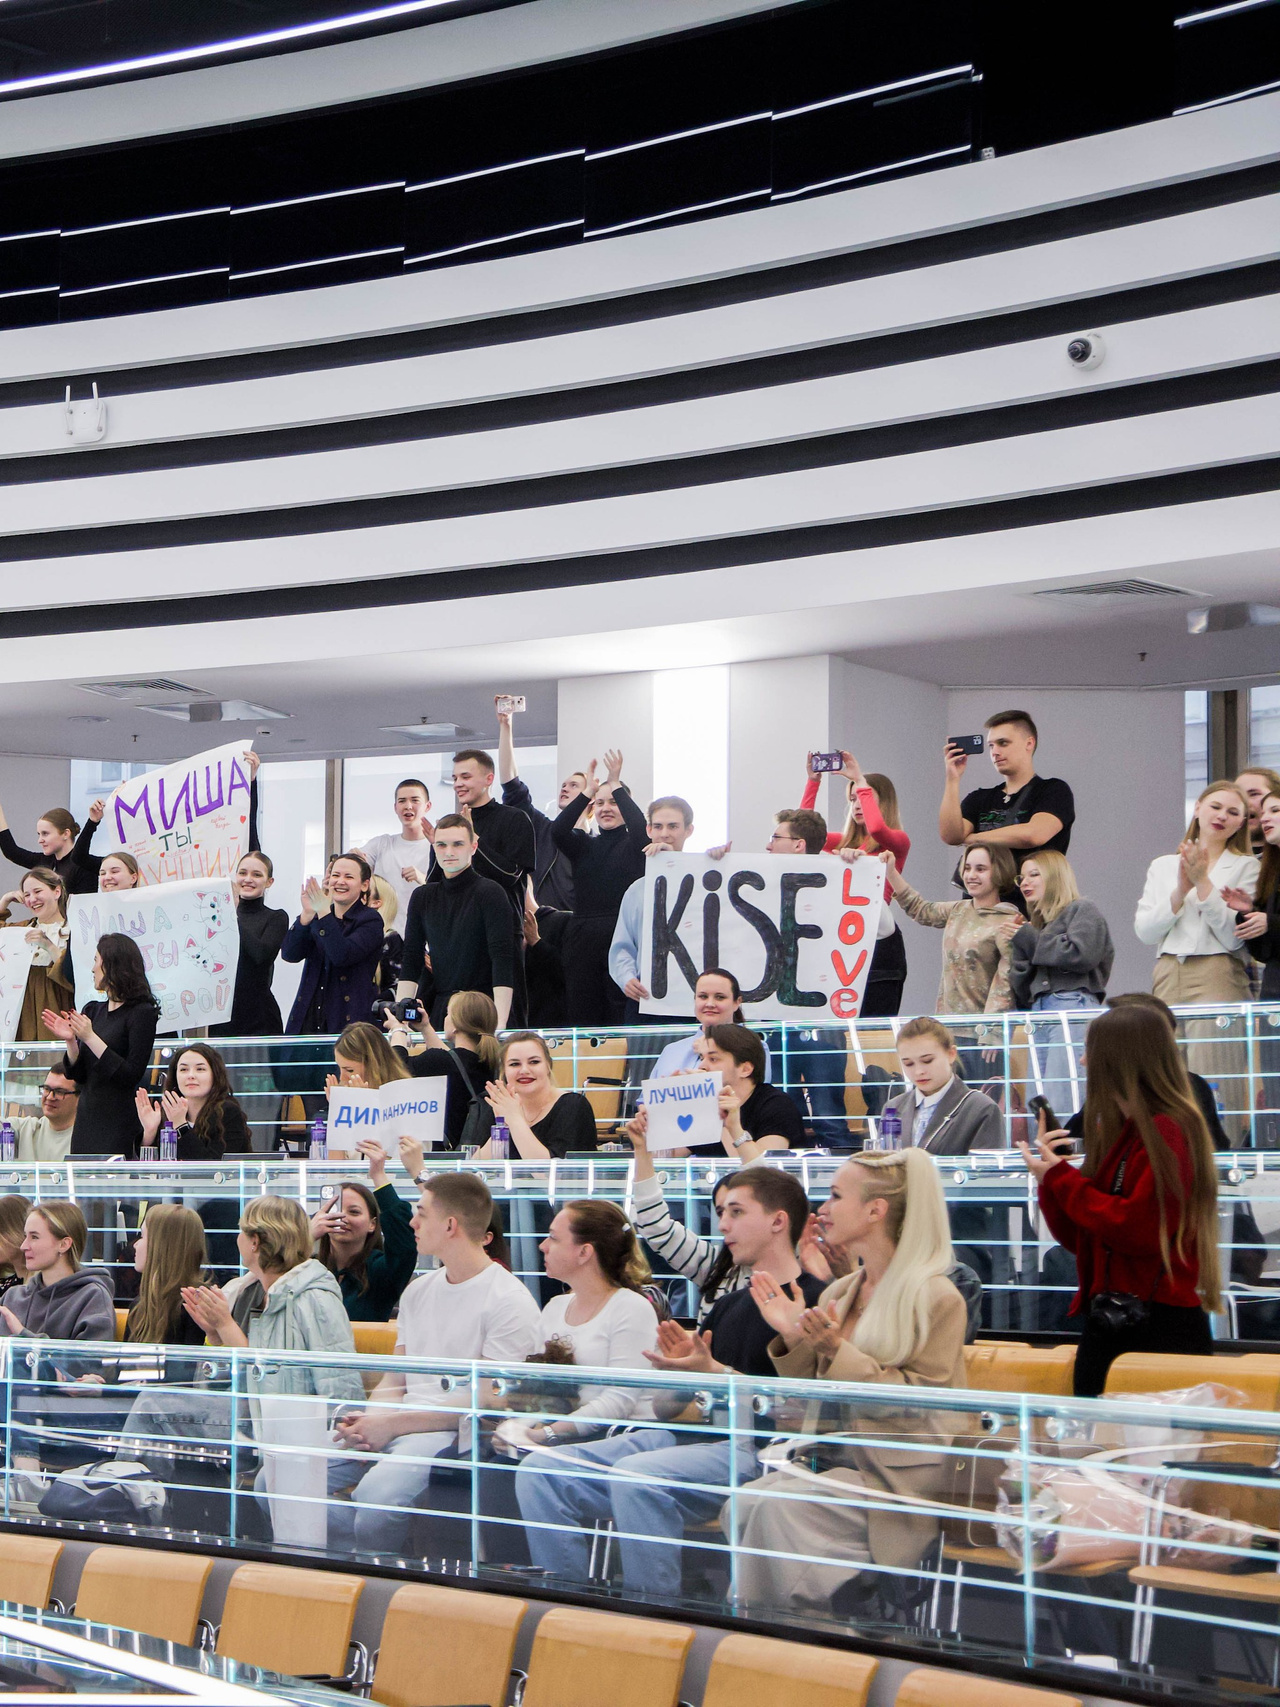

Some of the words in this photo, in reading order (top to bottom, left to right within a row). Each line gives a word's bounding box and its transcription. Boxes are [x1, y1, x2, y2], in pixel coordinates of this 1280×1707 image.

[114, 756, 251, 844] МИША
[159, 826, 192, 851] ТЫ
[139, 940, 179, 973] ТЫ
[648, 1078, 716, 1105] ЛУЧШИЙ
[334, 1105, 380, 1128] ДИМ
[382, 1100, 439, 1122] КАНУНОВ
